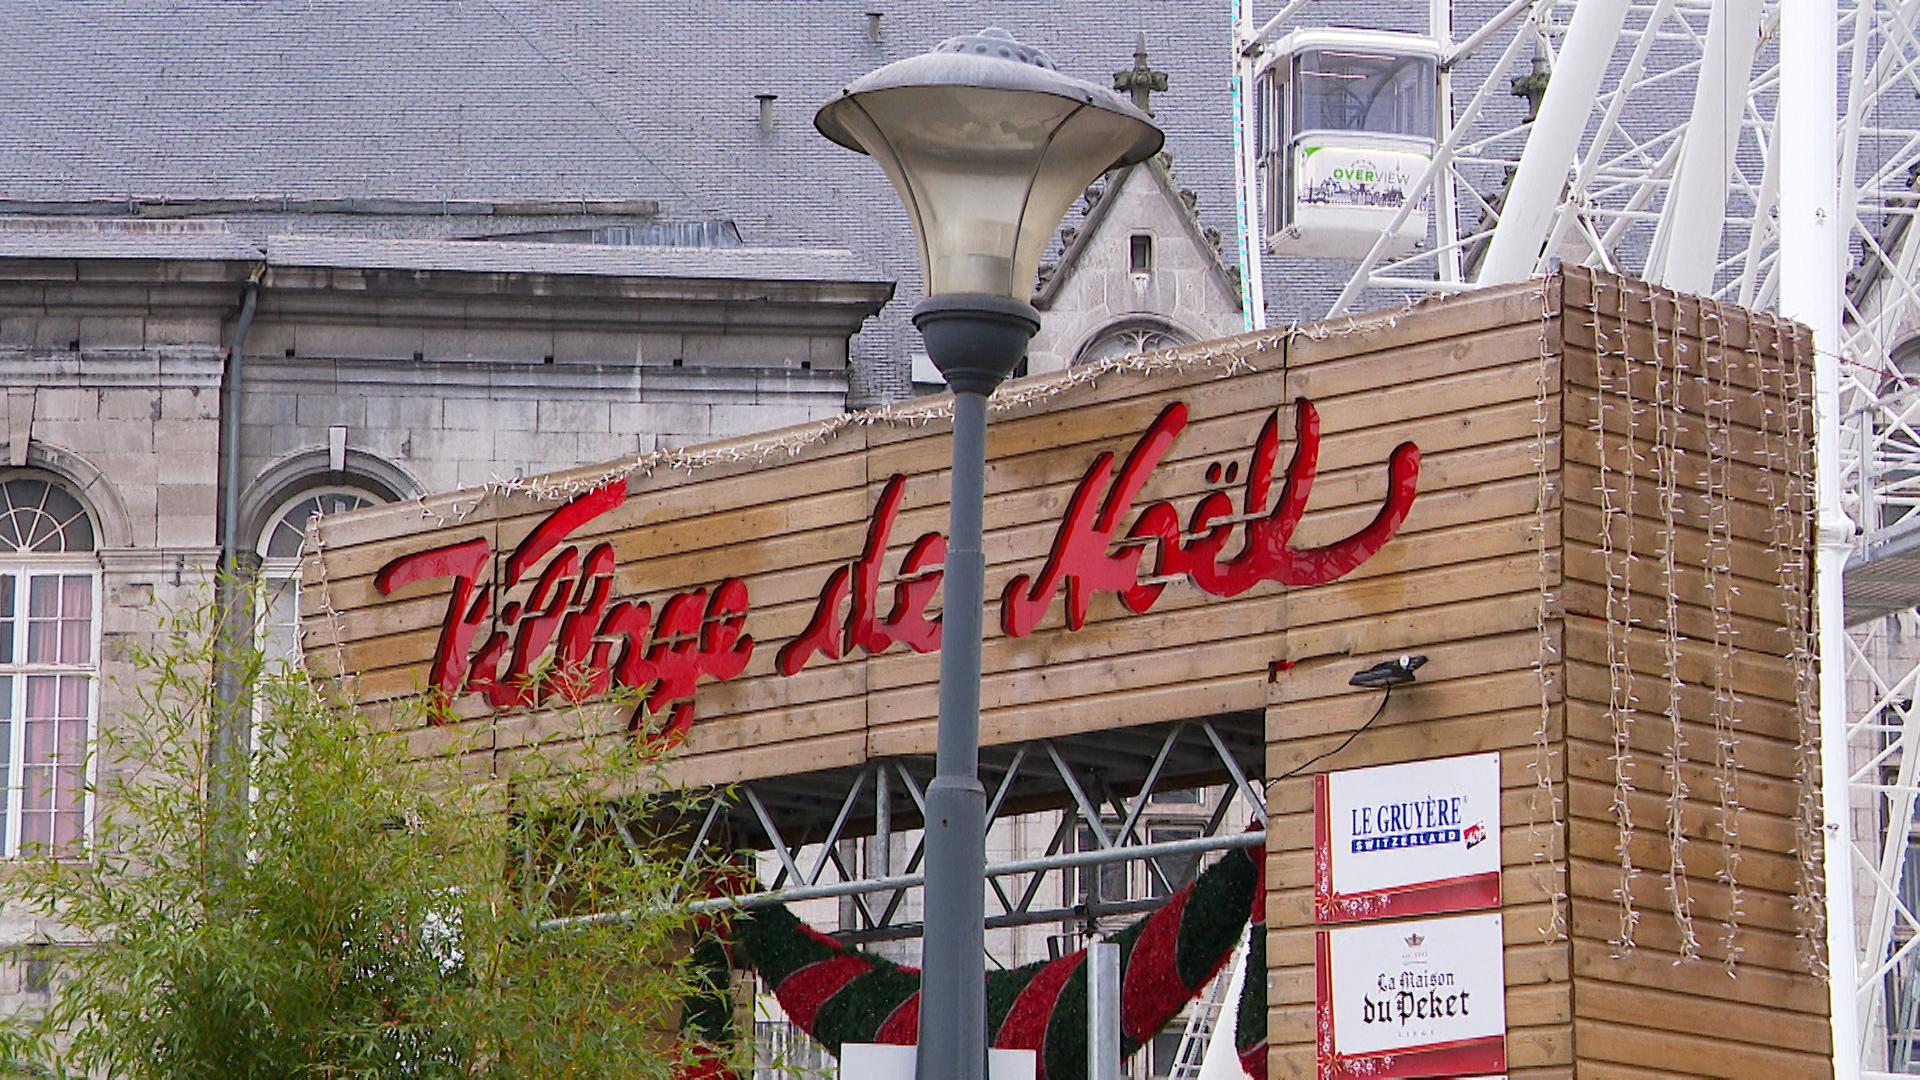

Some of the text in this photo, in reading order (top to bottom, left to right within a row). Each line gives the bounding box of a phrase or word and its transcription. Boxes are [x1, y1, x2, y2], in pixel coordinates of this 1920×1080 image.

[1333, 167, 1410, 186] OVERVIEW
[1001, 399, 1421, 638] Noël
[1351, 794, 1461, 836] LE GRUYÈRE
[1355, 831, 1457, 851] SWITZERLAND
[1377, 969, 1456, 992] La Maison
[1363, 988, 1471, 1028] du Peket
